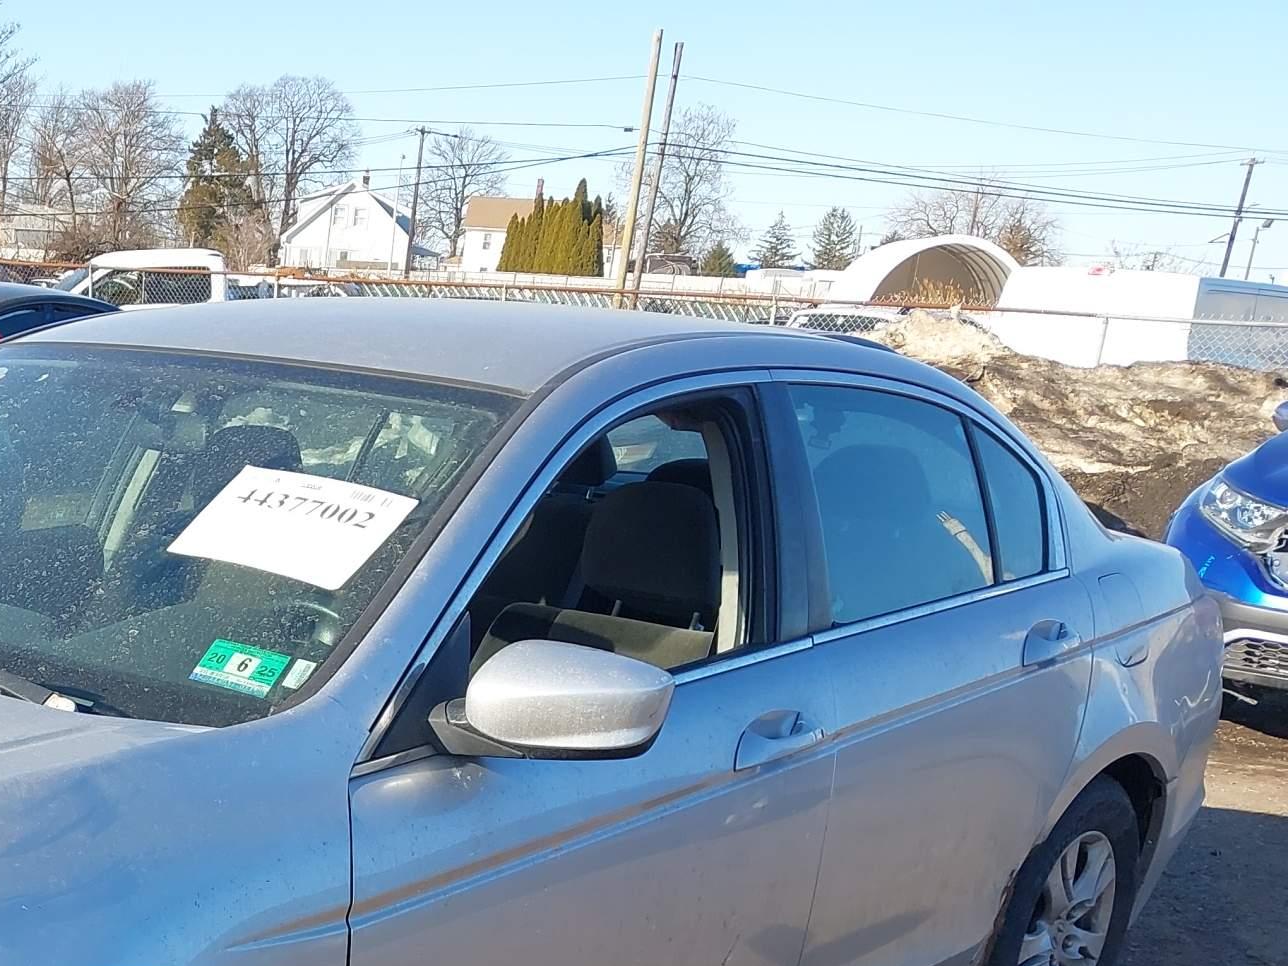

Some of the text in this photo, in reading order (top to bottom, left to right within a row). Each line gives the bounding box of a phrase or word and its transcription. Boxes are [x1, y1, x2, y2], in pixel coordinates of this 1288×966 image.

[236, 488, 376, 529] 44377002
[207, 652, 227, 665] 20
[236, 657, 253, 673] 6
[256, 665, 278, 678] 25
